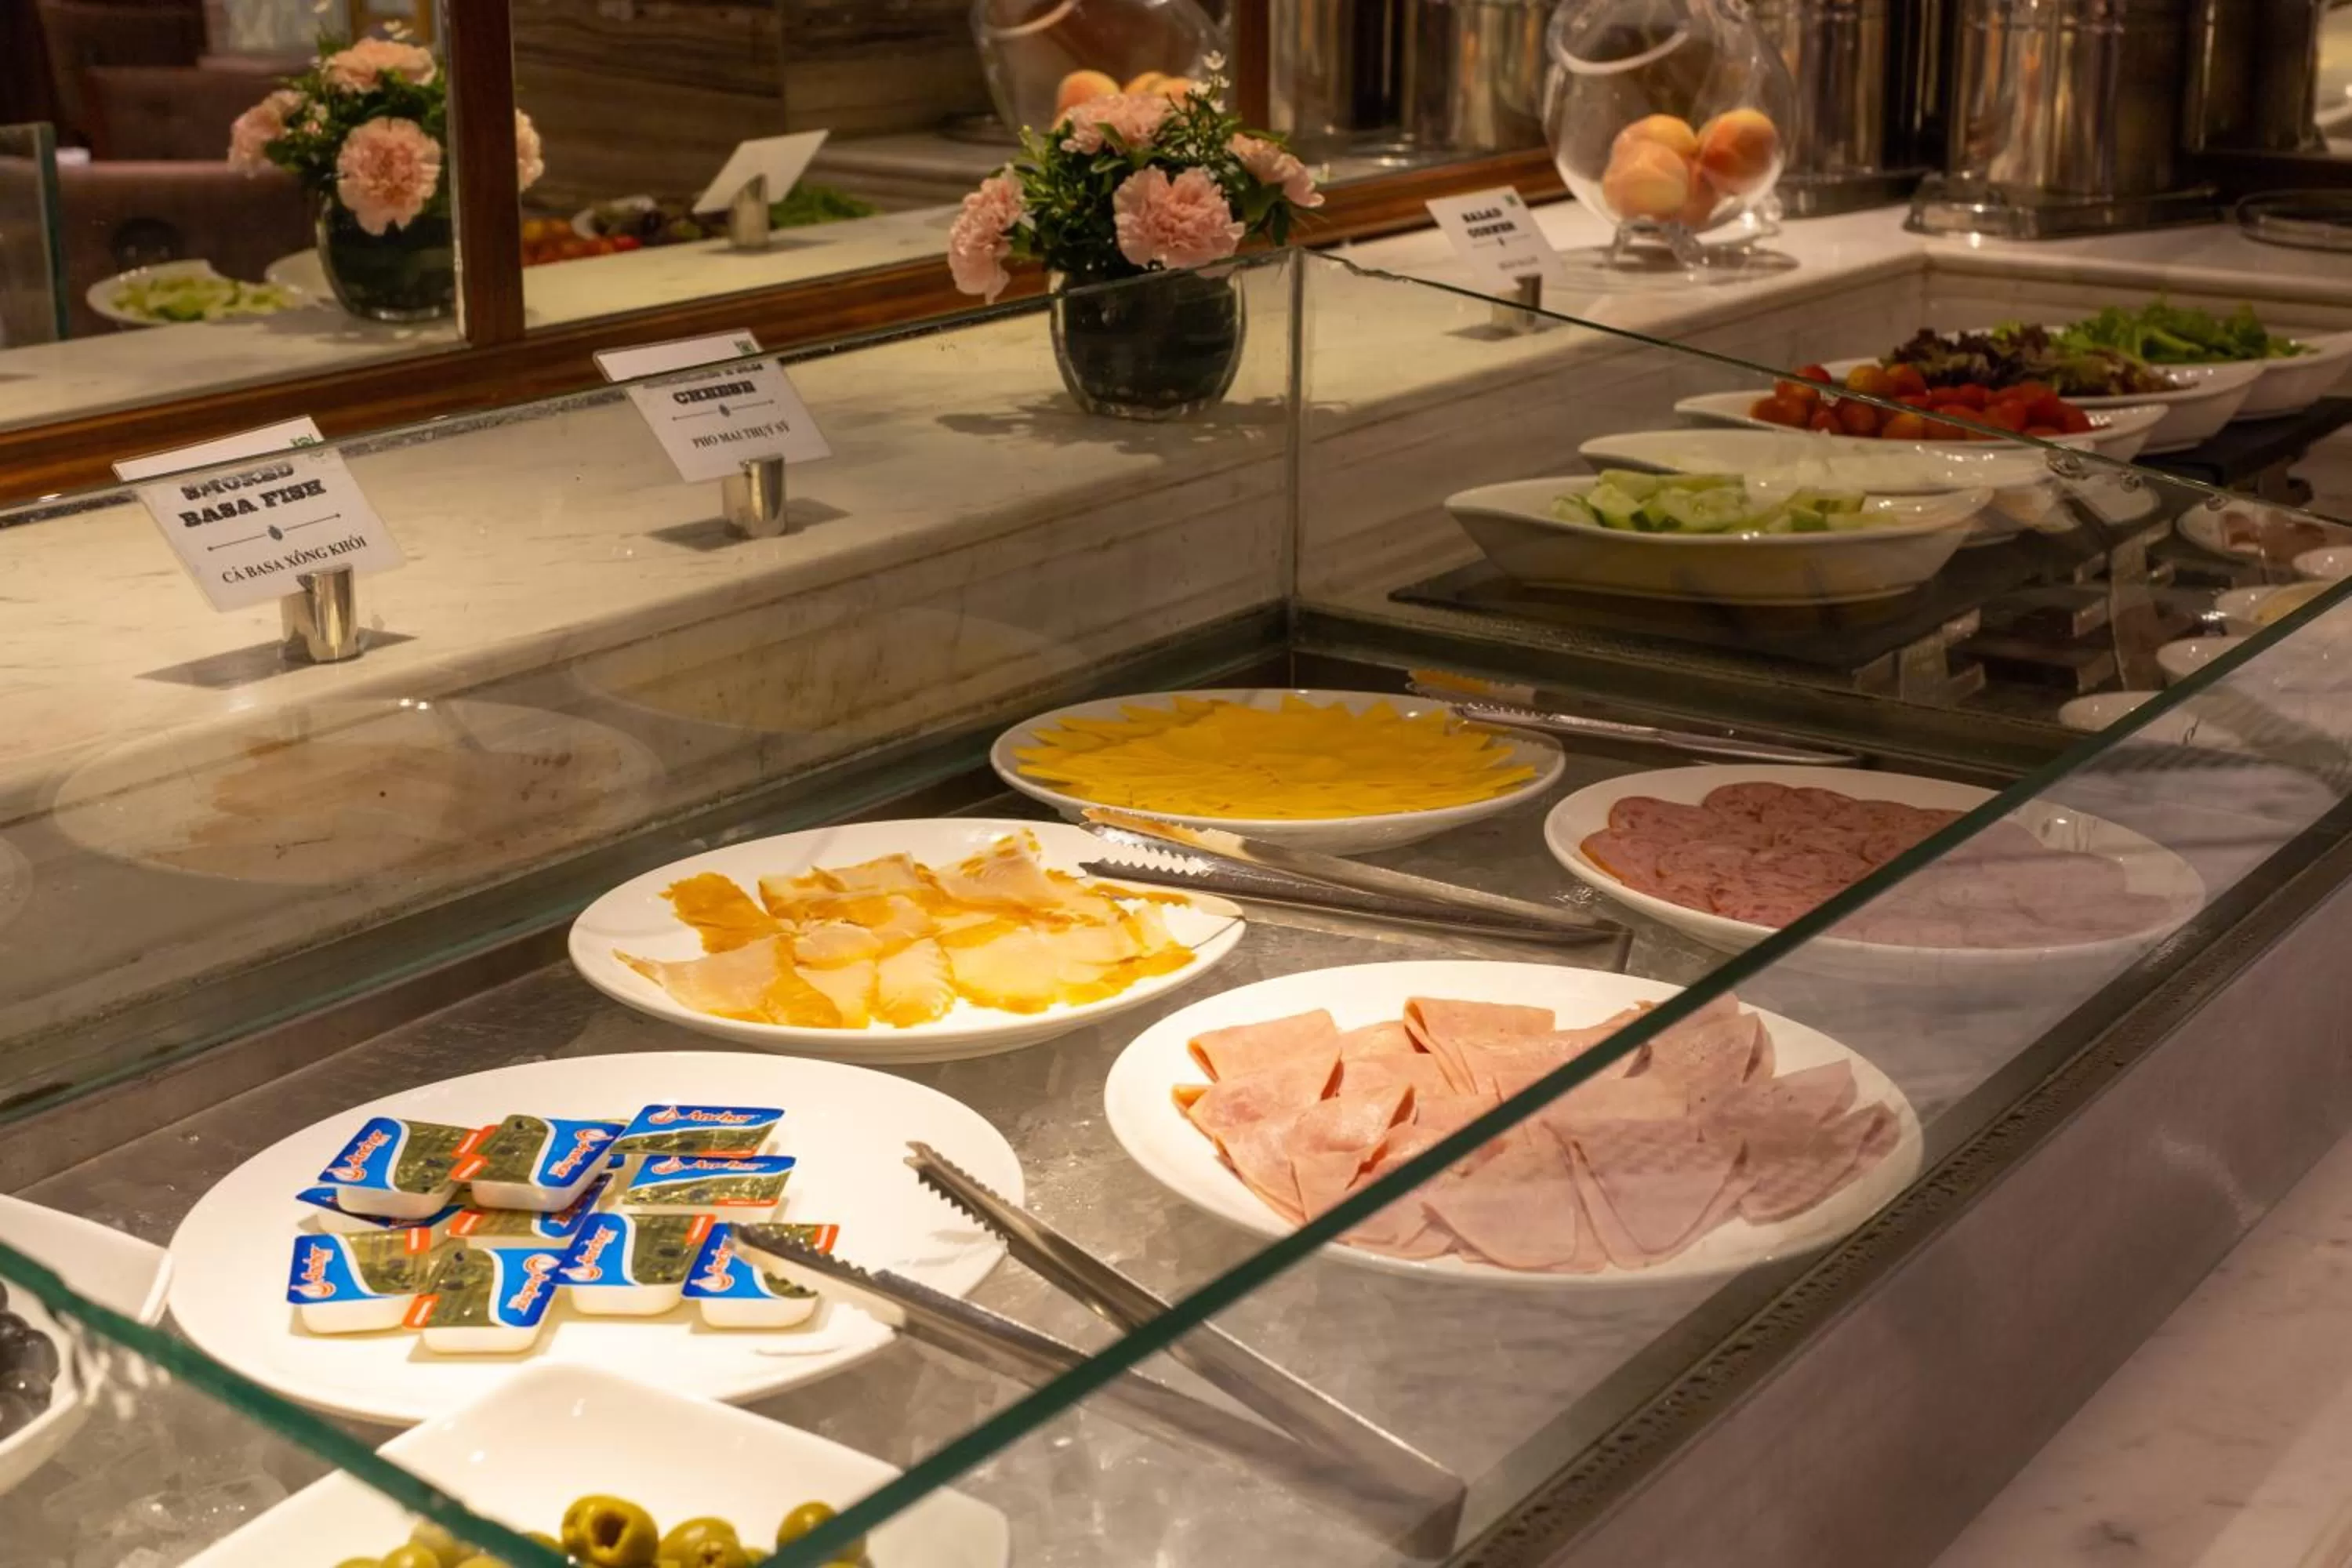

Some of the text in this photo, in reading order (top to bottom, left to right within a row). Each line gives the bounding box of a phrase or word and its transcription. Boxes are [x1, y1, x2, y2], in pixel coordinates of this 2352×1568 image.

[673, 380, 757, 404] CHEESE
[178, 479, 326, 528] BASA FISH
[222, 535, 368, 583] CÁ BASA XÔNG KHÓI
[681, 1109, 757, 1124] Anchor
[344, 1130, 391, 1168] Anchor
[548, 1139, 595, 1178] Anchor
[301, 1243, 334, 1283] Anchor
[576, 1225, 619, 1265] Anchor
[506, 1269, 550, 1316] Anchor
